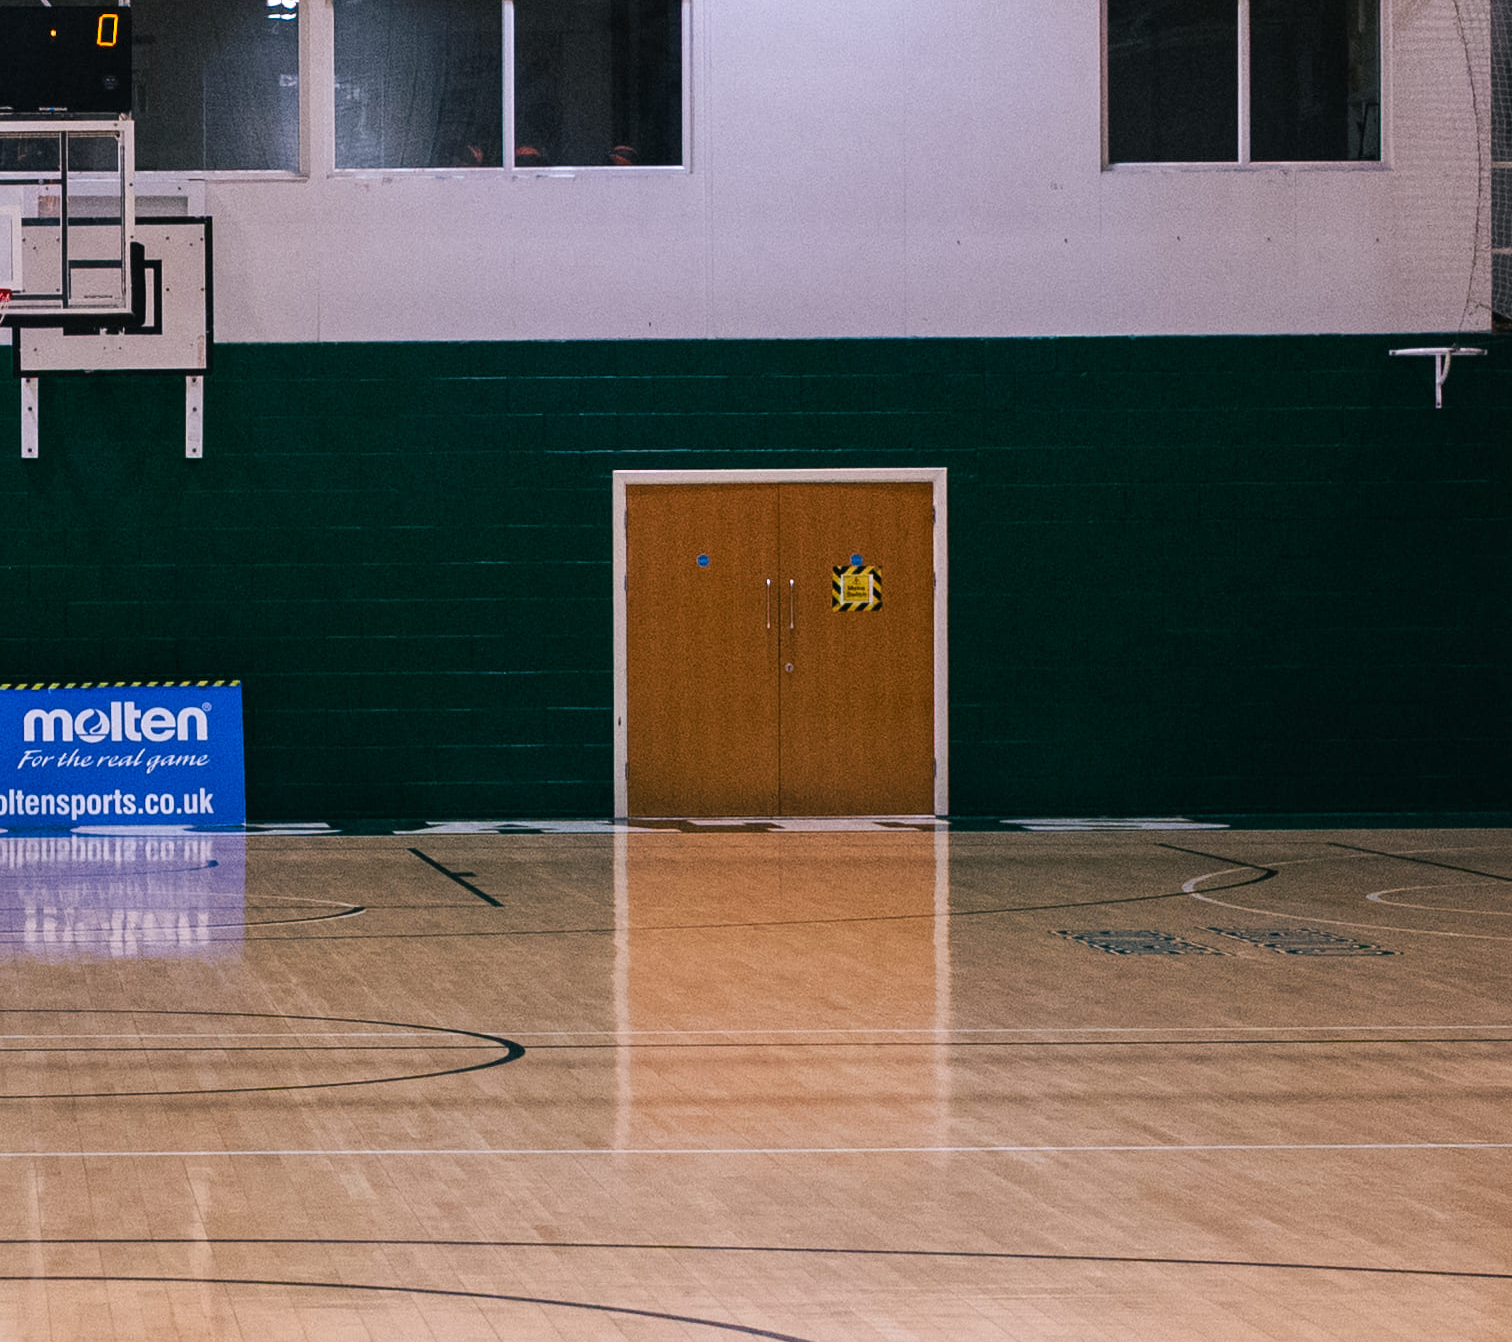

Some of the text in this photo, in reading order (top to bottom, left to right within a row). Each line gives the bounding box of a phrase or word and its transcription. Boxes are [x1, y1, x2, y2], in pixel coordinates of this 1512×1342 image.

[97, 13, 119, 47] 0
[23, 701, 208, 743] molten
[17, 748, 210, 774] For the real game
